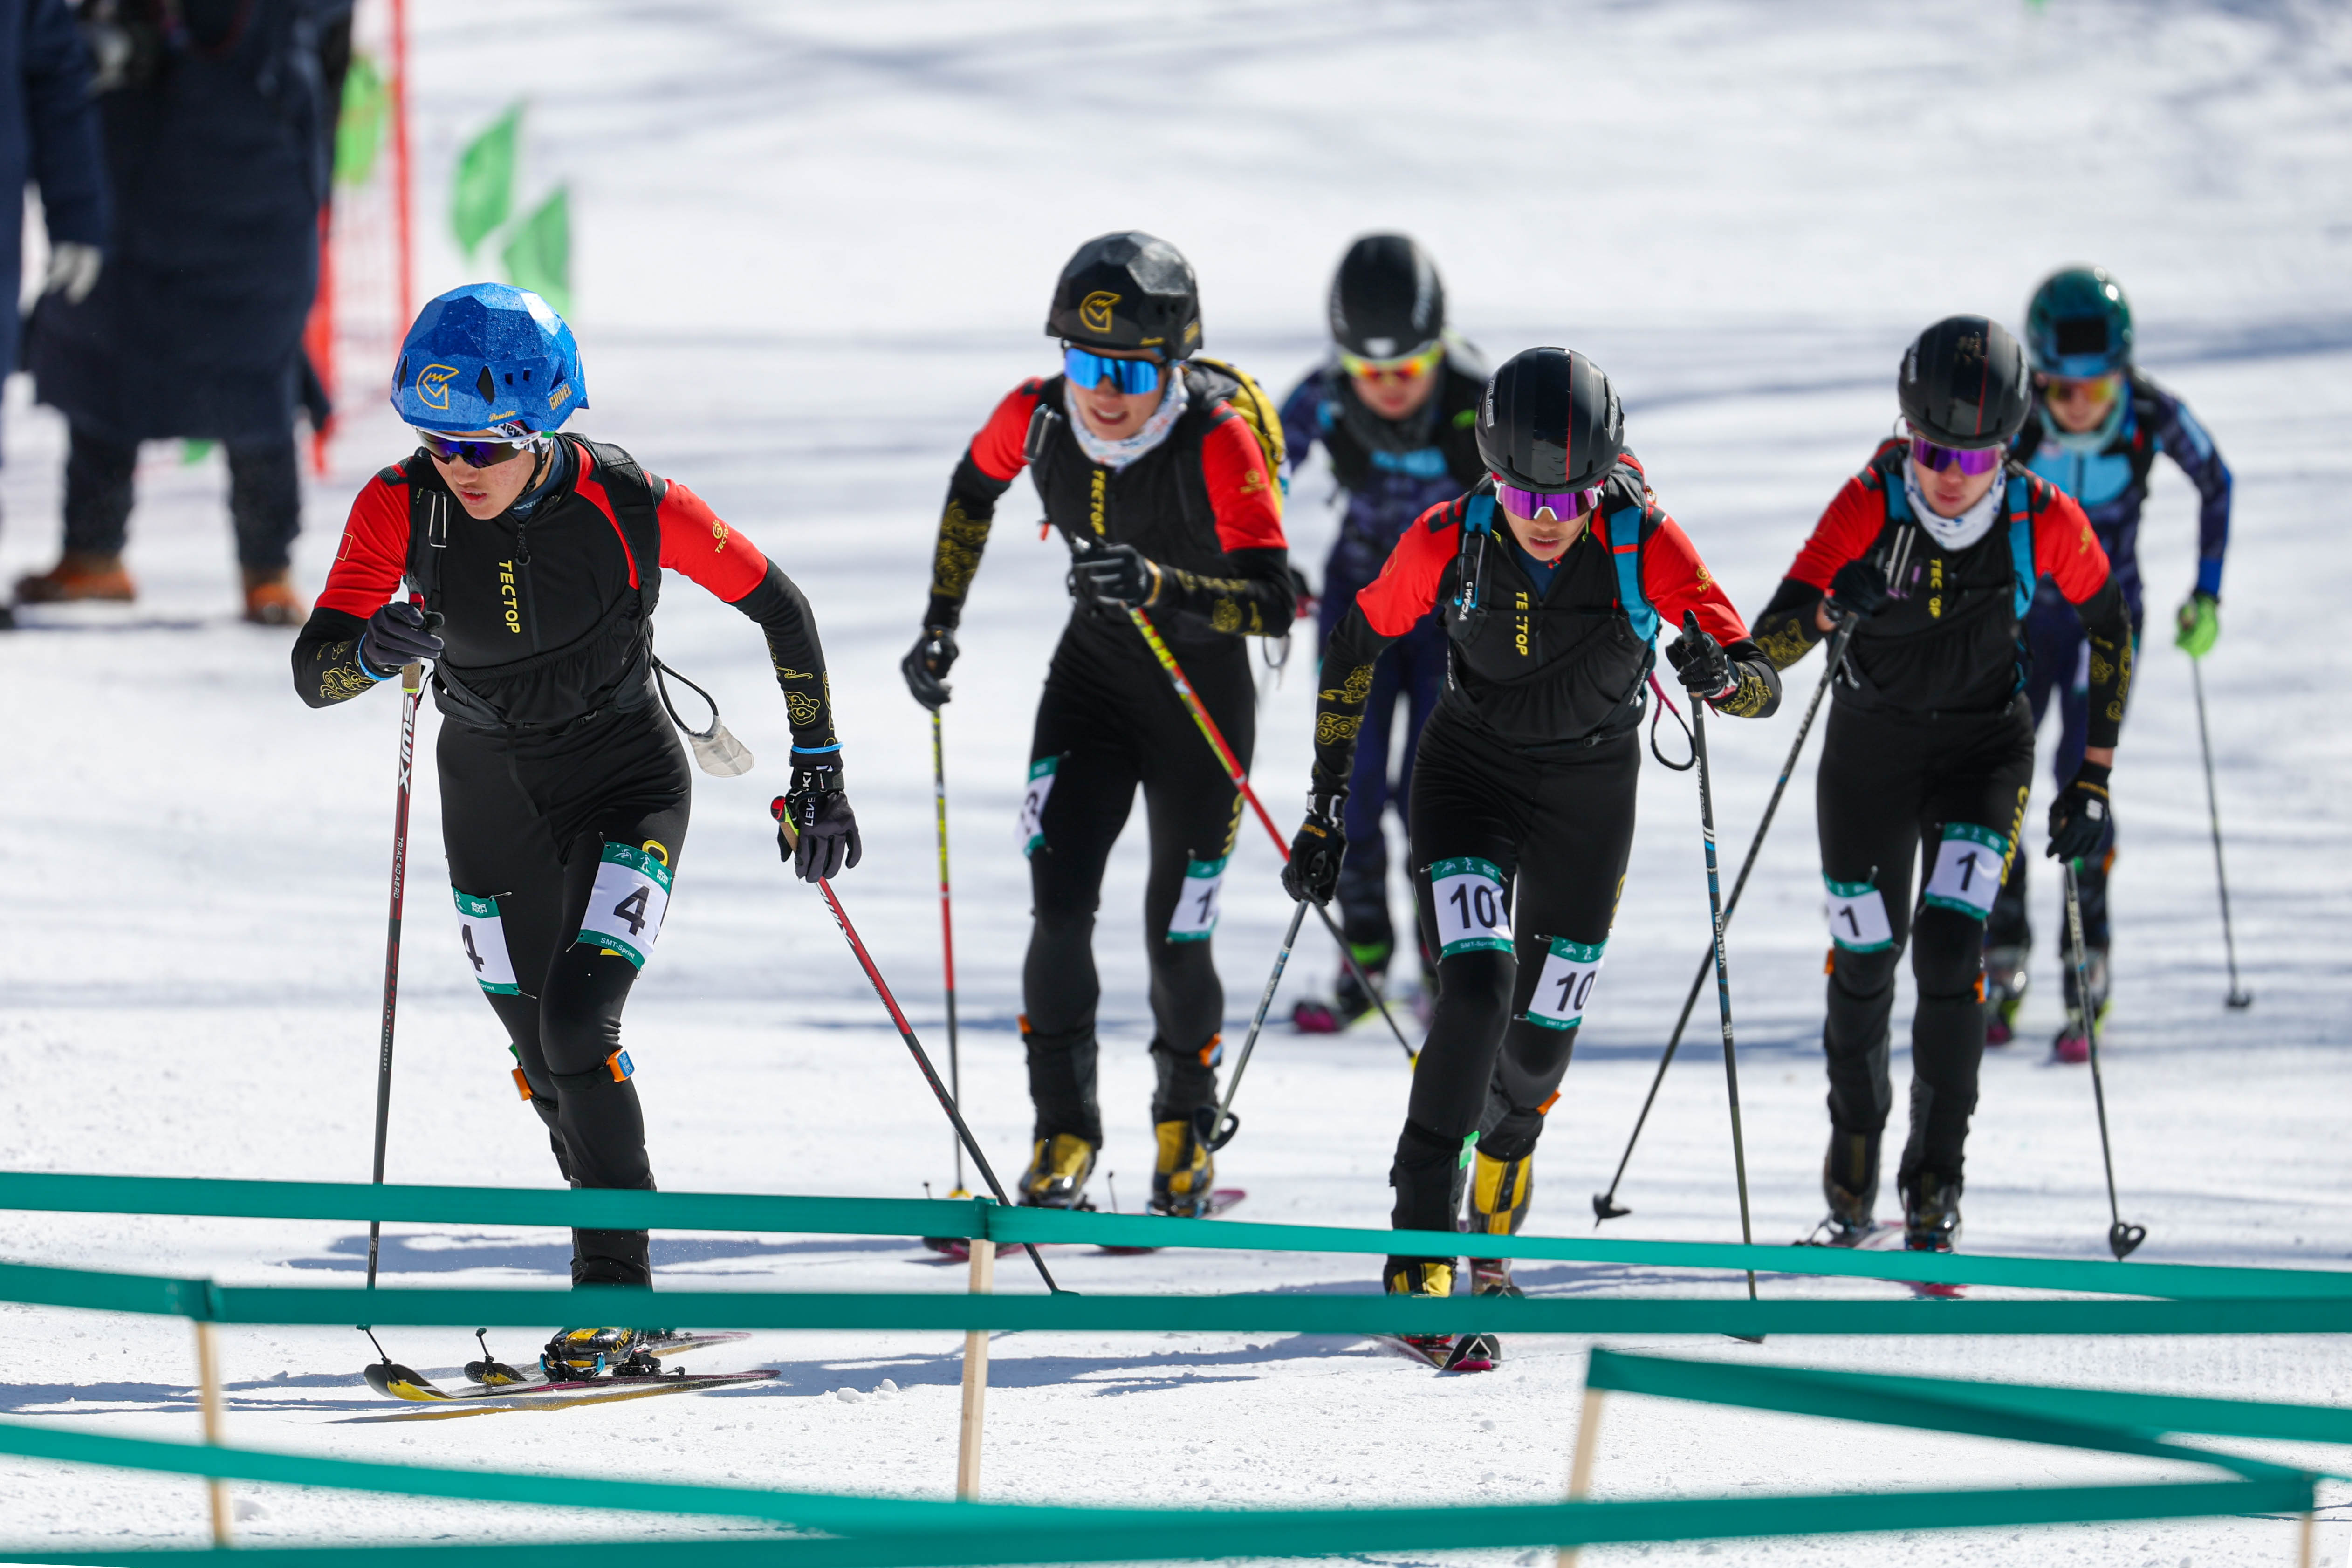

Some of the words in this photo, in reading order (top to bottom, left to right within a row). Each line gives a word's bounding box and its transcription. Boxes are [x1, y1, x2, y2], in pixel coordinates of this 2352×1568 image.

[489, 411, 517, 422] Duetto
[549, 383, 572, 411] GRIVEL
[1090, 470, 1106, 535] TECTOP
[499, 560, 521, 633] TECTOP
[1929, 558, 1942, 618] TECOP
[399, 696, 414, 794] SWIX
[789, 772, 812, 796] LKI
[805, 797, 816, 826] LEVE
[1957, 851, 1977, 892] 1
[613, 885, 650, 936] 4
[1450, 884, 1497, 928] 10
[1839, 904, 1860, 937] 1
[462, 924, 484, 972] 4
[601, 937, 635, 959] SMT-Sprint
[1714, 910, 1726, 968] VERTICAL
[1557, 970, 1596, 1011] 10
[620, 1327, 632, 1343] SPO
